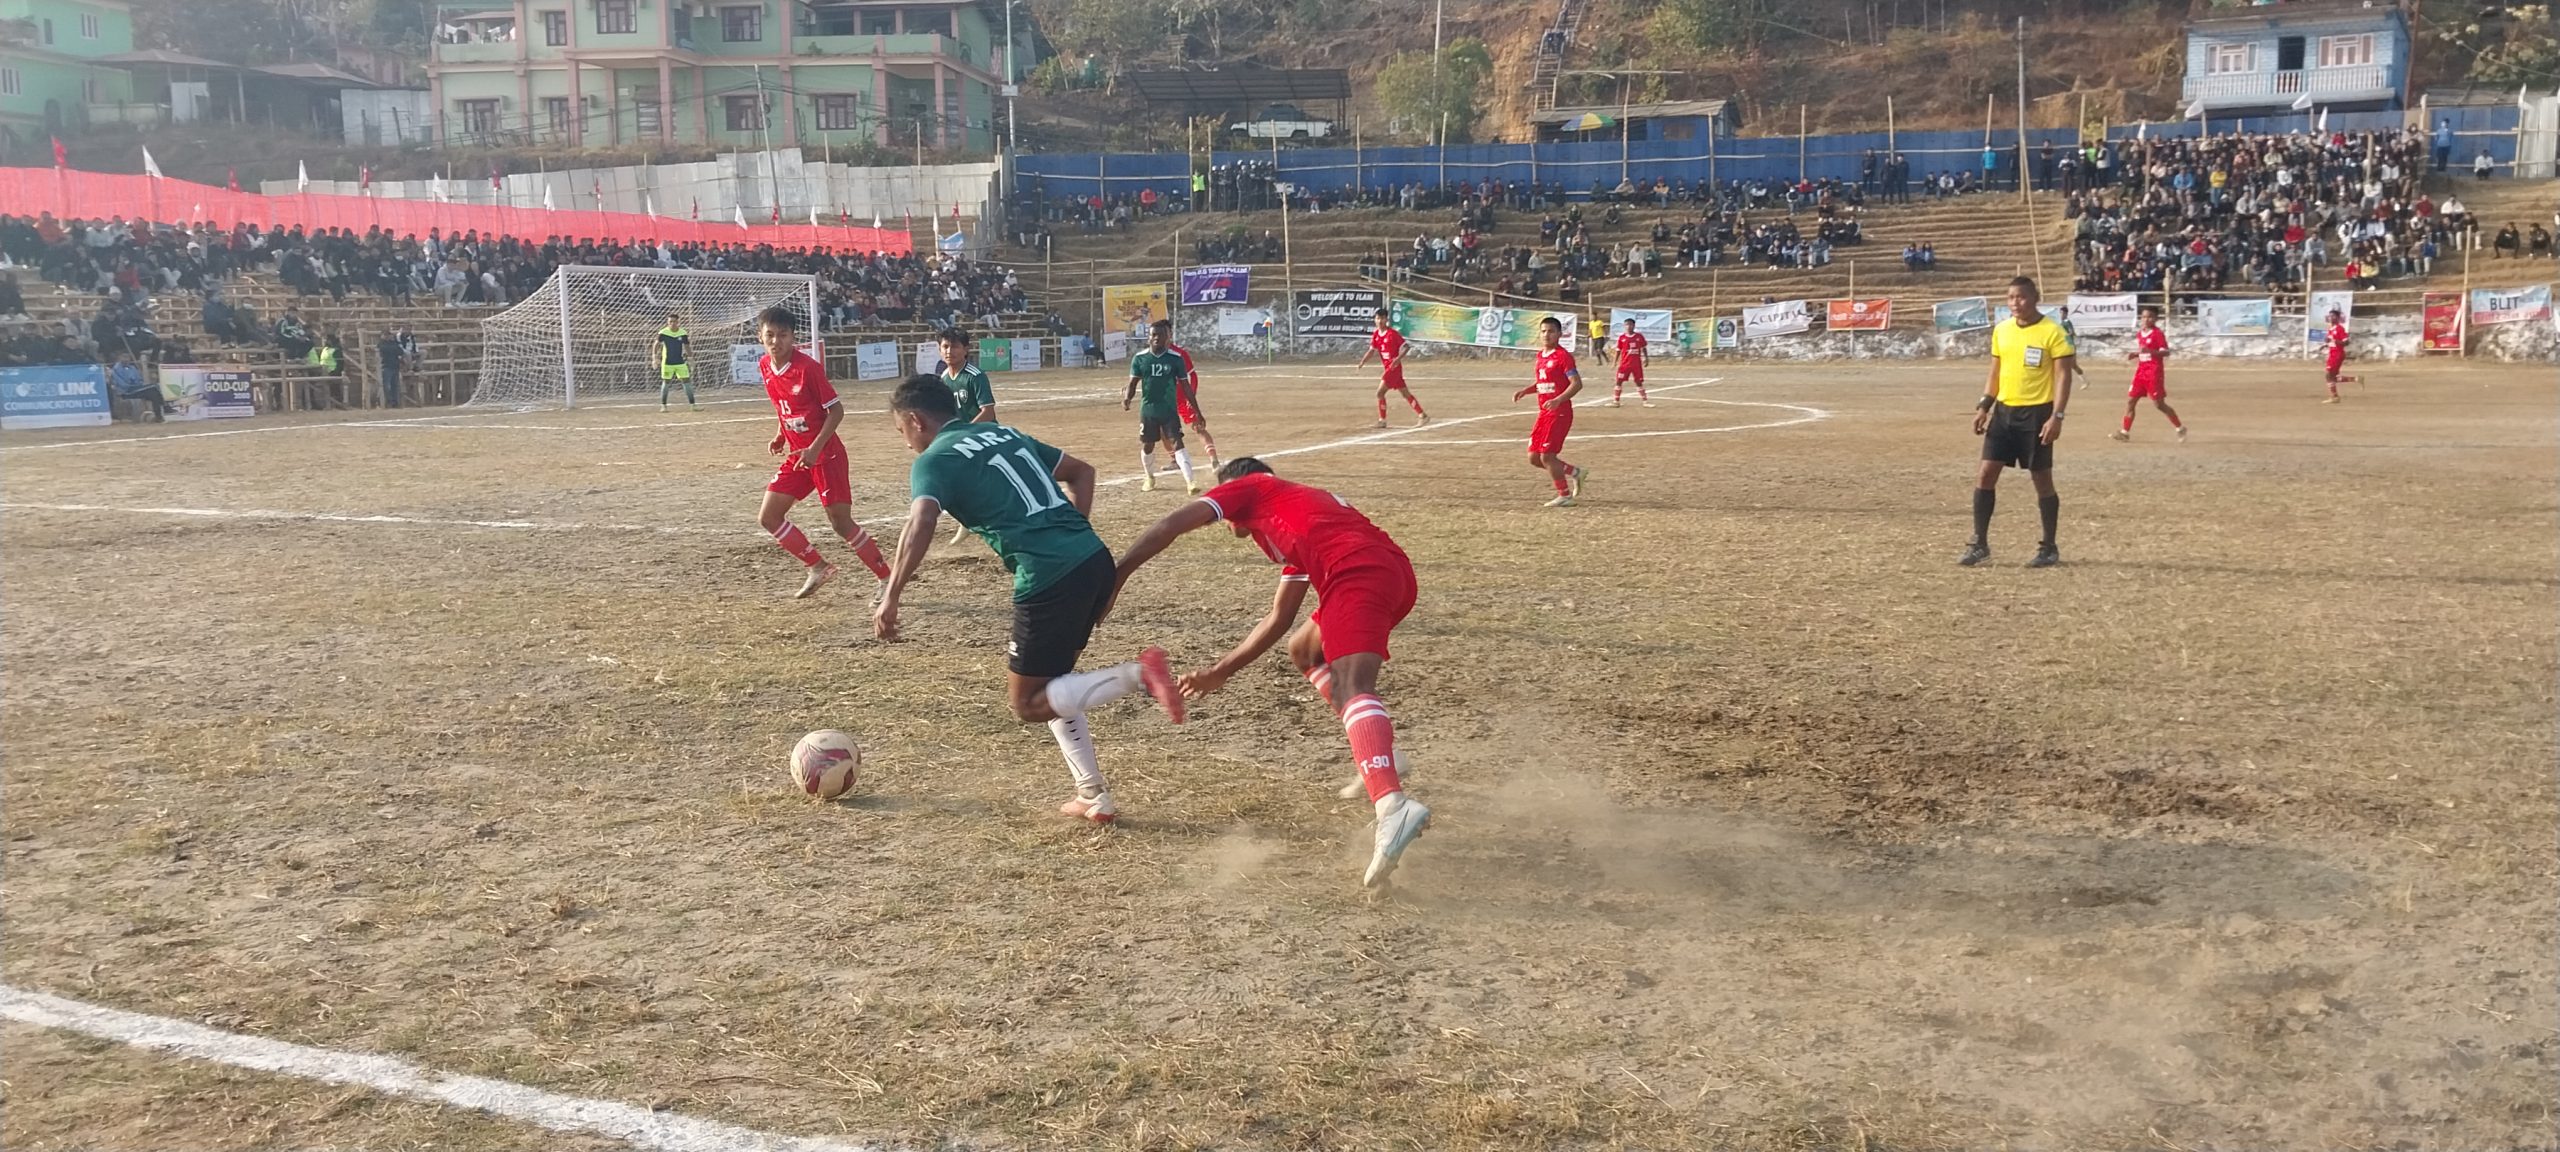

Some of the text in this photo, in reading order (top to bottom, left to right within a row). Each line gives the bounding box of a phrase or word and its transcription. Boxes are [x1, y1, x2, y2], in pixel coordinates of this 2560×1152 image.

[1200, 287, 1228, 301] TVS
[1310, 292, 1374, 301] WELCOME TO ILAM
[2084, 303, 2136, 313] CAPITAL
[1151, 363, 1163, 377] 12
[205, 381, 249, 392] GOLD-CUP
[3, 399, 101, 411] COMMUNICATION LTD
[778, 399, 792, 415] 15
[987, 448, 1067, 516] 11
[1360, 755, 1390, 775] T-90
